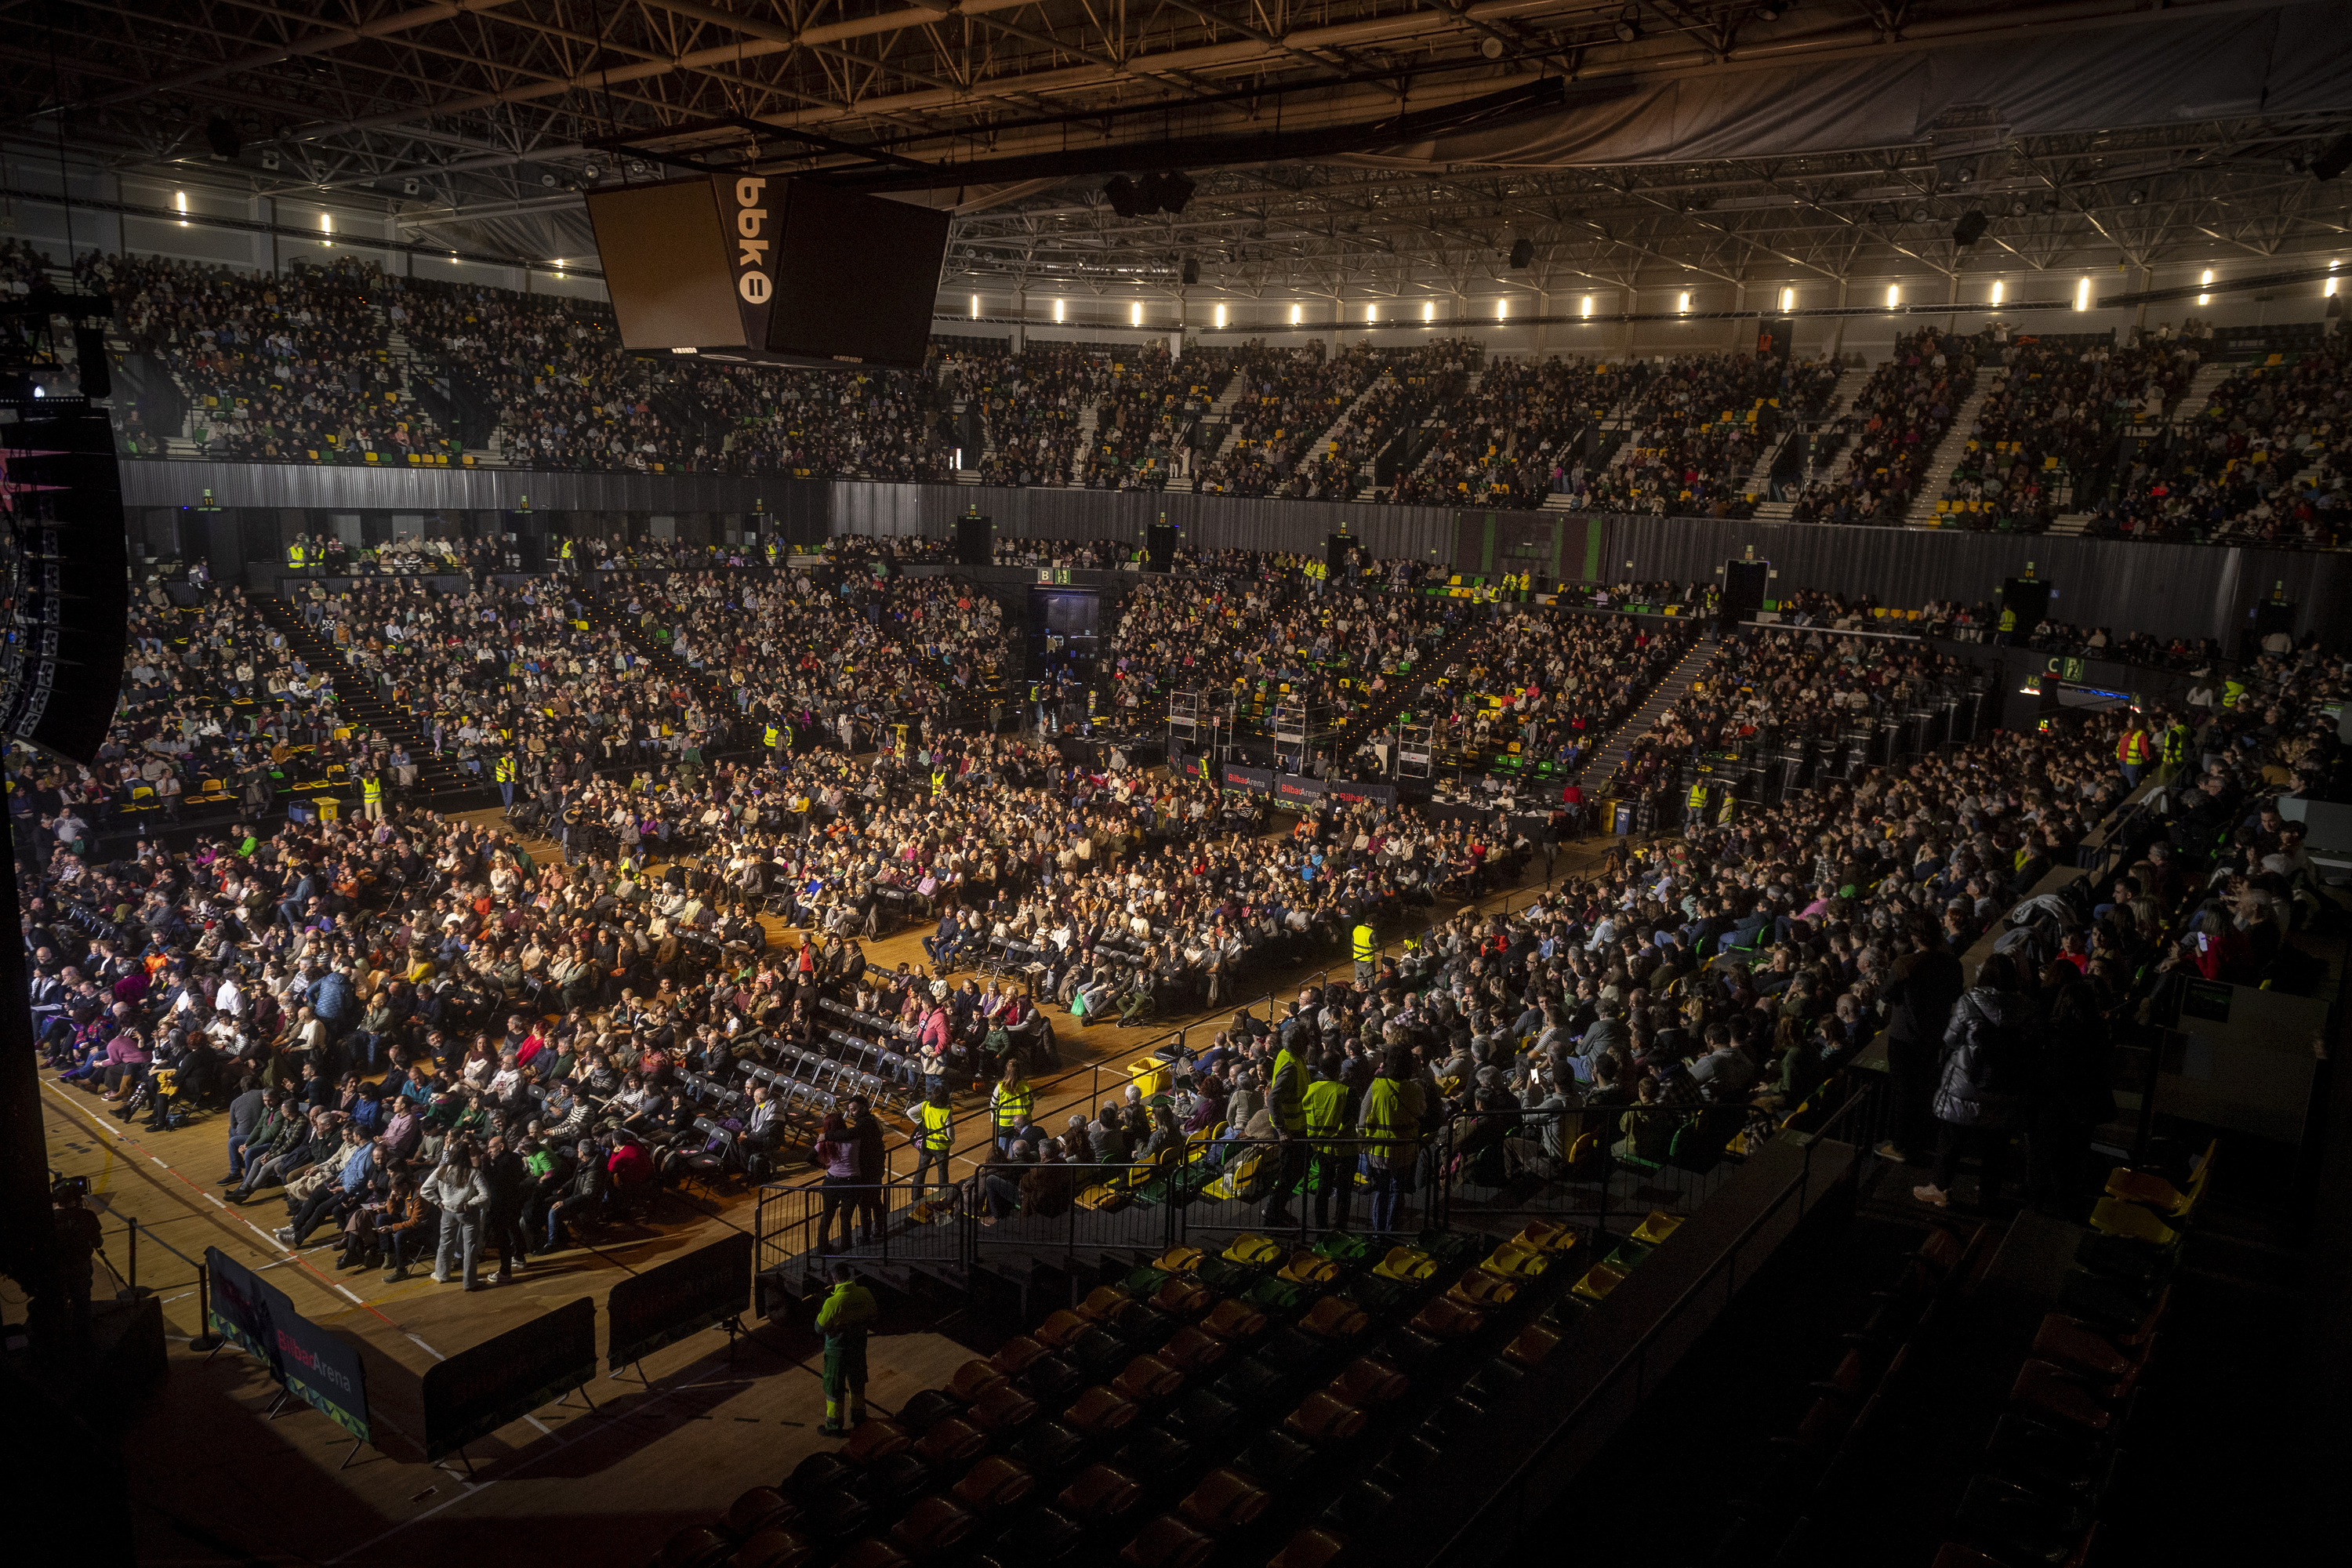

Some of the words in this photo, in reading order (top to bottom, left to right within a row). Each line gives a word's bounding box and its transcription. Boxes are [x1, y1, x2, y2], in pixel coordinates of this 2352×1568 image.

[735, 176, 769, 267] bbk
[1041, 570, 1049, 580] B
[2048, 657, 2060, 673] C
[2027, 676, 2040, 686] 16
